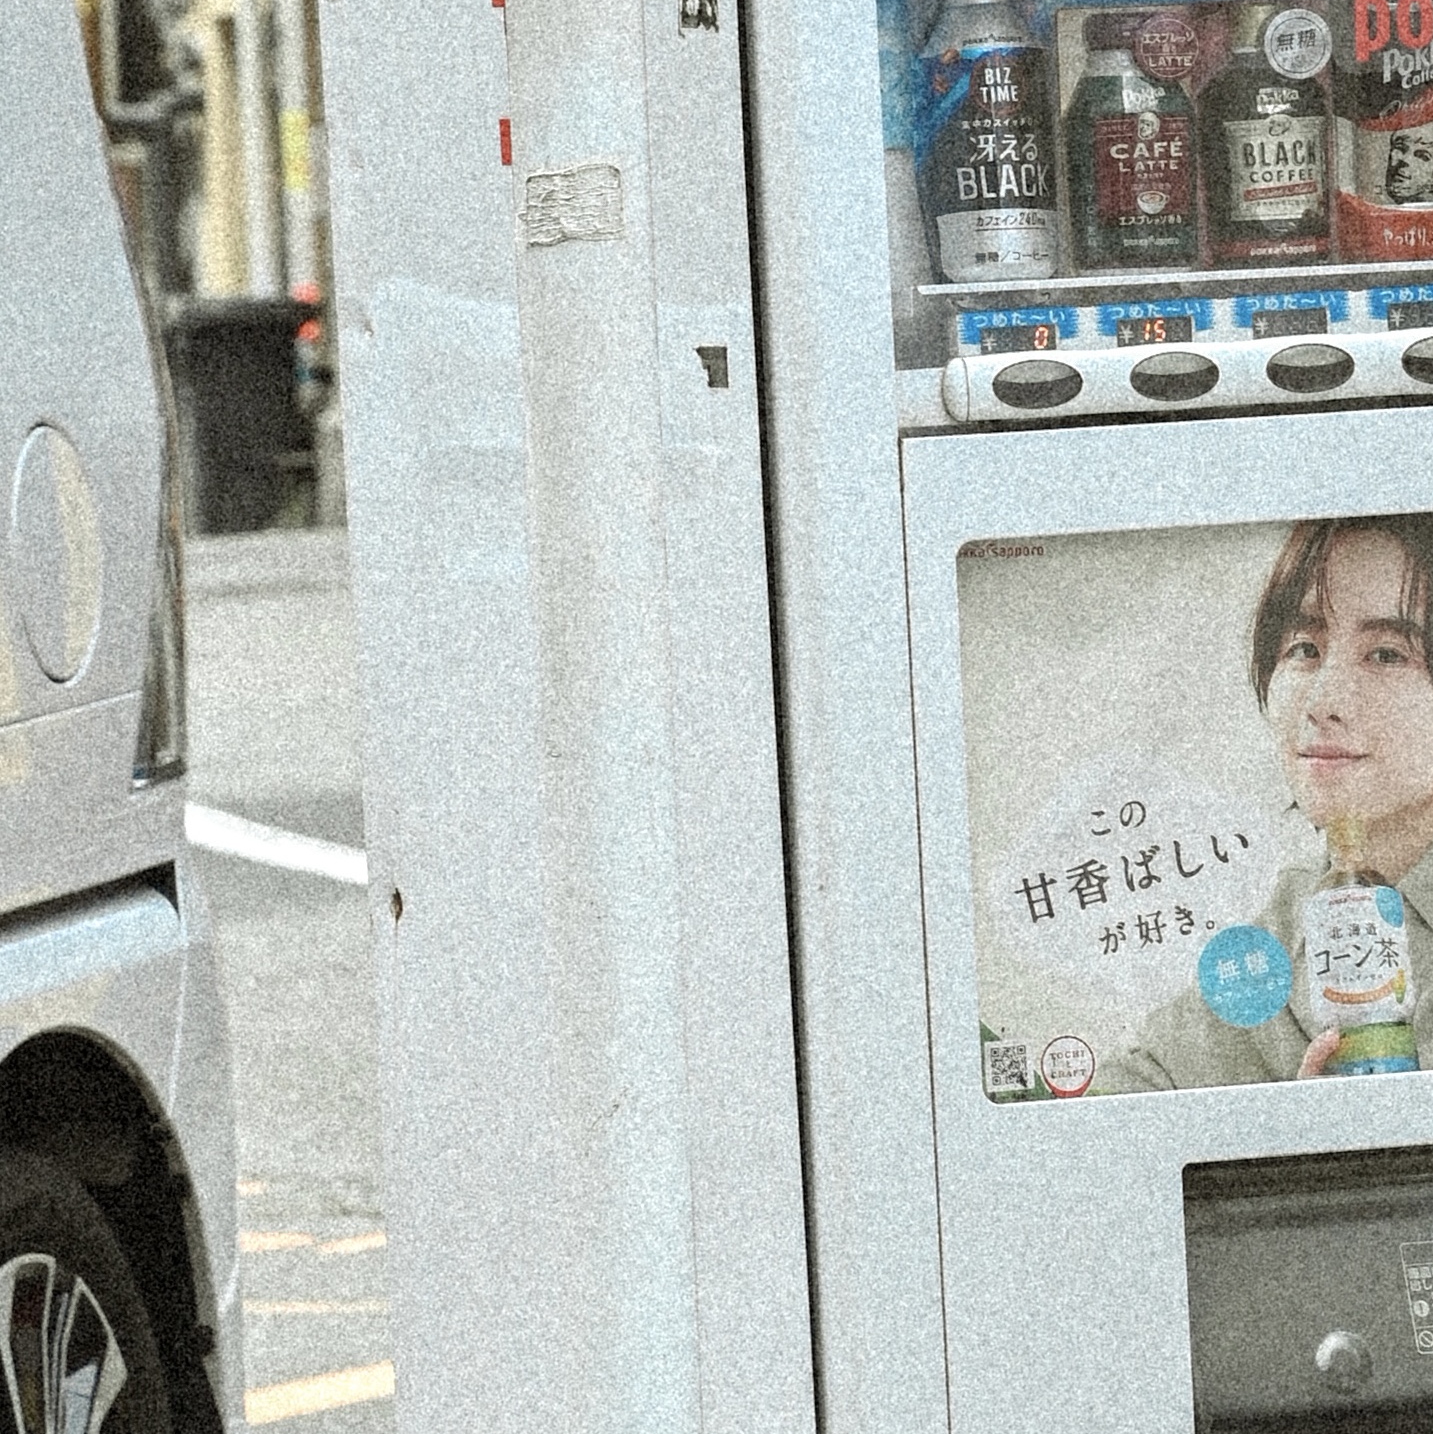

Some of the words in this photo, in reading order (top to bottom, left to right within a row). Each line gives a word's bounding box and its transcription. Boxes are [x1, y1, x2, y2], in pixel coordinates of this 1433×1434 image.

[1276, 29, 1317, 52] 無糖
[1149, 55, 1193, 67] LATTE
[984, 67, 1012, 85] BIZ
[979, 86, 1018, 104] TIME
[969, 133, 1038, 164] 冴える
[1110, 138, 1184, 160] CAFÉ
[1242, 137, 1317, 167] BLACK
[1118, 159, 1180, 173] LATTE
[1249, 168, 1314, 183] COFFEE
[956, 164, 1048, 201] BLACK
[1089, 801, 1147, 837] この
[1014, 832, 1251, 925] 甘香ばしい
[1099, 904, 1217, 955] が好き。
[1314, 938, 1400, 977] コーン茶
[1050, 1049, 1085, 1062] TOCHI
[1051, 1069, 1087, 1079] CRAFT
